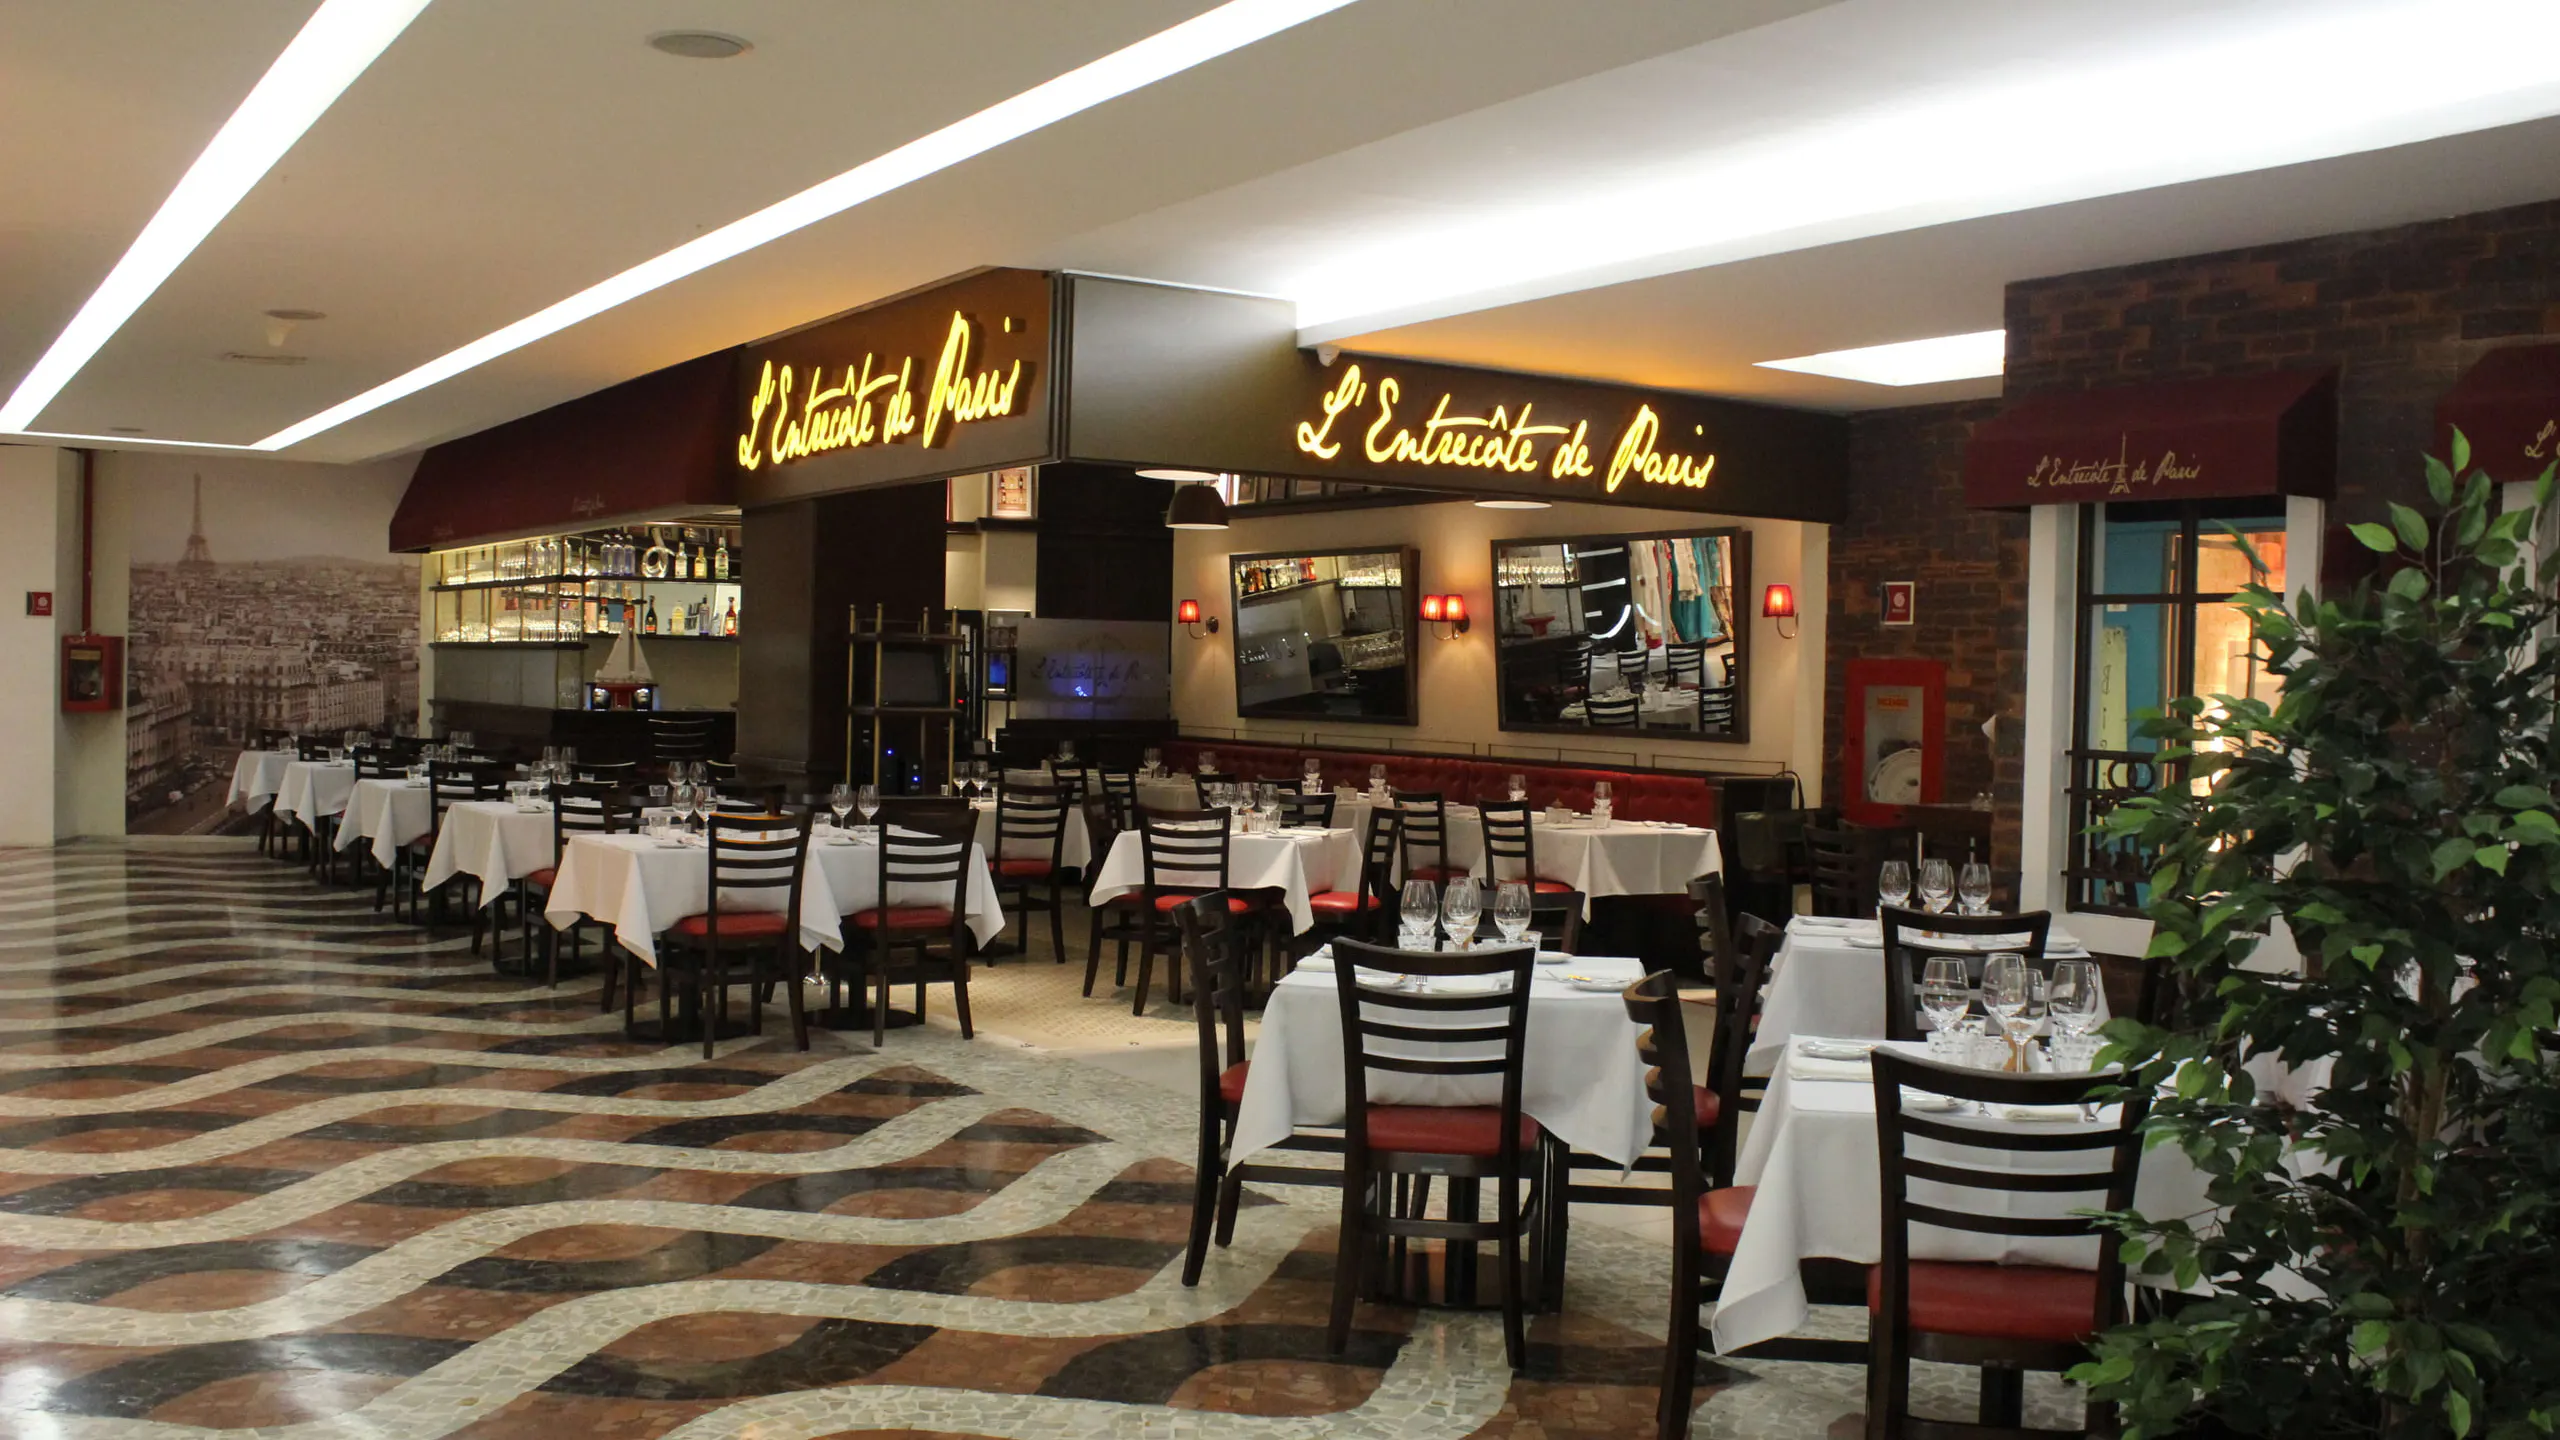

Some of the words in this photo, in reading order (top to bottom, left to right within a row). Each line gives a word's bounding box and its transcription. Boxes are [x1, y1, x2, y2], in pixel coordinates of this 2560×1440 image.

[883, 356, 915, 444] de
[922, 310, 1020, 449] Paris
[1552, 419, 1594, 479] de
[1606, 404, 1715, 493] Paris
[2131, 460, 2148, 483] de
[2152, 450, 2201, 486] Paris
